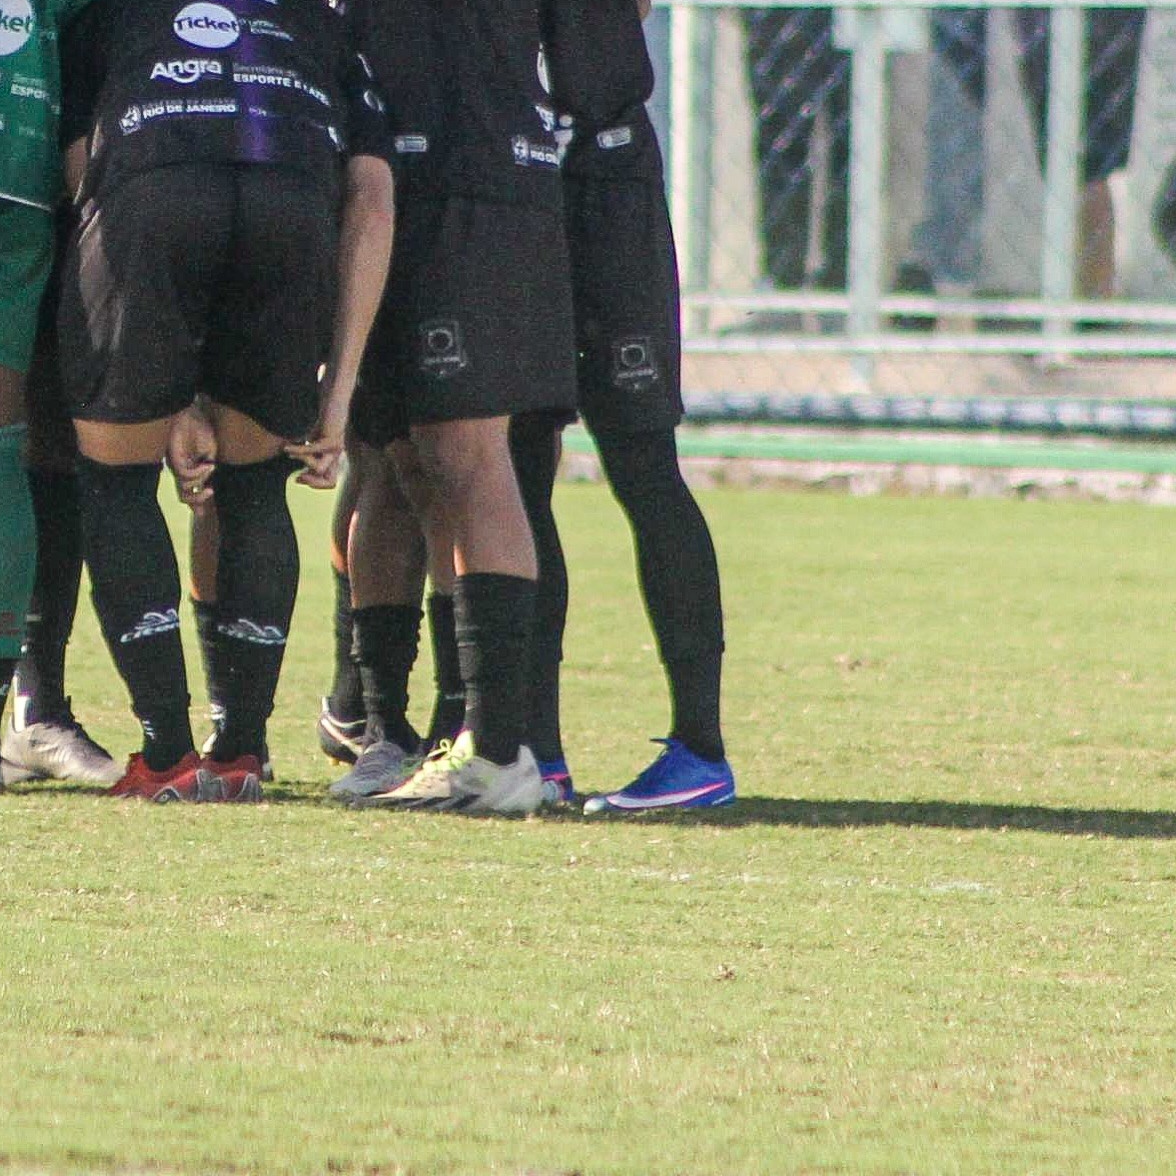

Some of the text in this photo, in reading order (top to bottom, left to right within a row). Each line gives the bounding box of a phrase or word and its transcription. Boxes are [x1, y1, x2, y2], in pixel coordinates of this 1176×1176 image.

[177, 15, 238, 32] Ticket
[150, 58, 222, 84] Angra
[233, 74, 291, 87] ESPORTE
[143, 104, 236, 119] RIO DE JANEIRO
